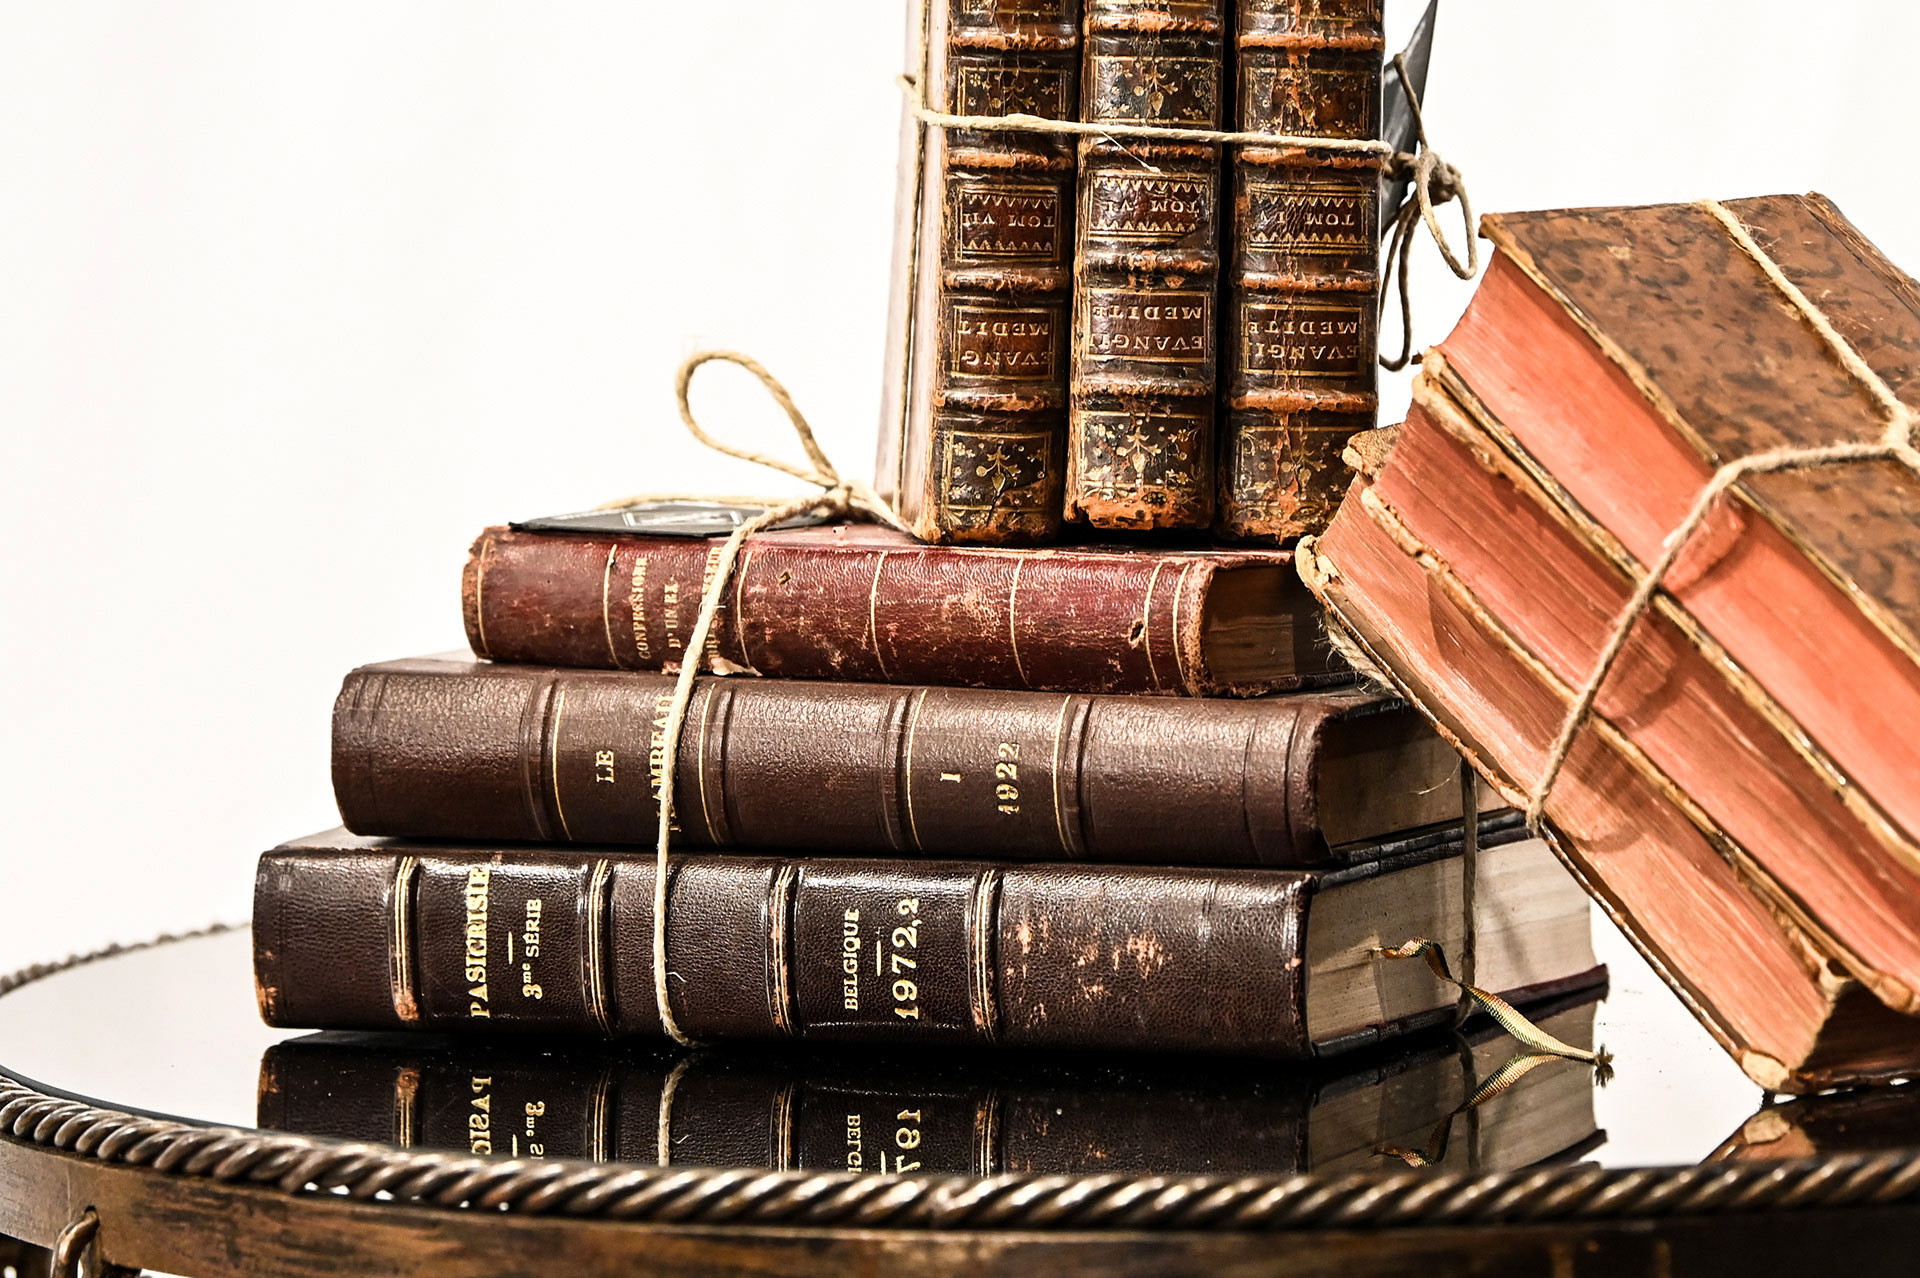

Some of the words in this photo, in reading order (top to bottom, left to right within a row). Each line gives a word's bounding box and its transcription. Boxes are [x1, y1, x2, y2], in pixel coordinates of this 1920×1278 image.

[1150, 199, 1200, 215] TOM
[1008, 215, 1055, 228] TOM
[1304, 212, 1355, 226] TOM
[1092, 304, 1203, 321] MEDITE
[1248, 320, 1358, 335] MEDITE
[594, 750, 615, 784] LE
[995, 742, 1020, 815] 1922
[465, 866, 491, 1019] PASICRISIE
[843, 908, 861, 1011] BELGIQUE
